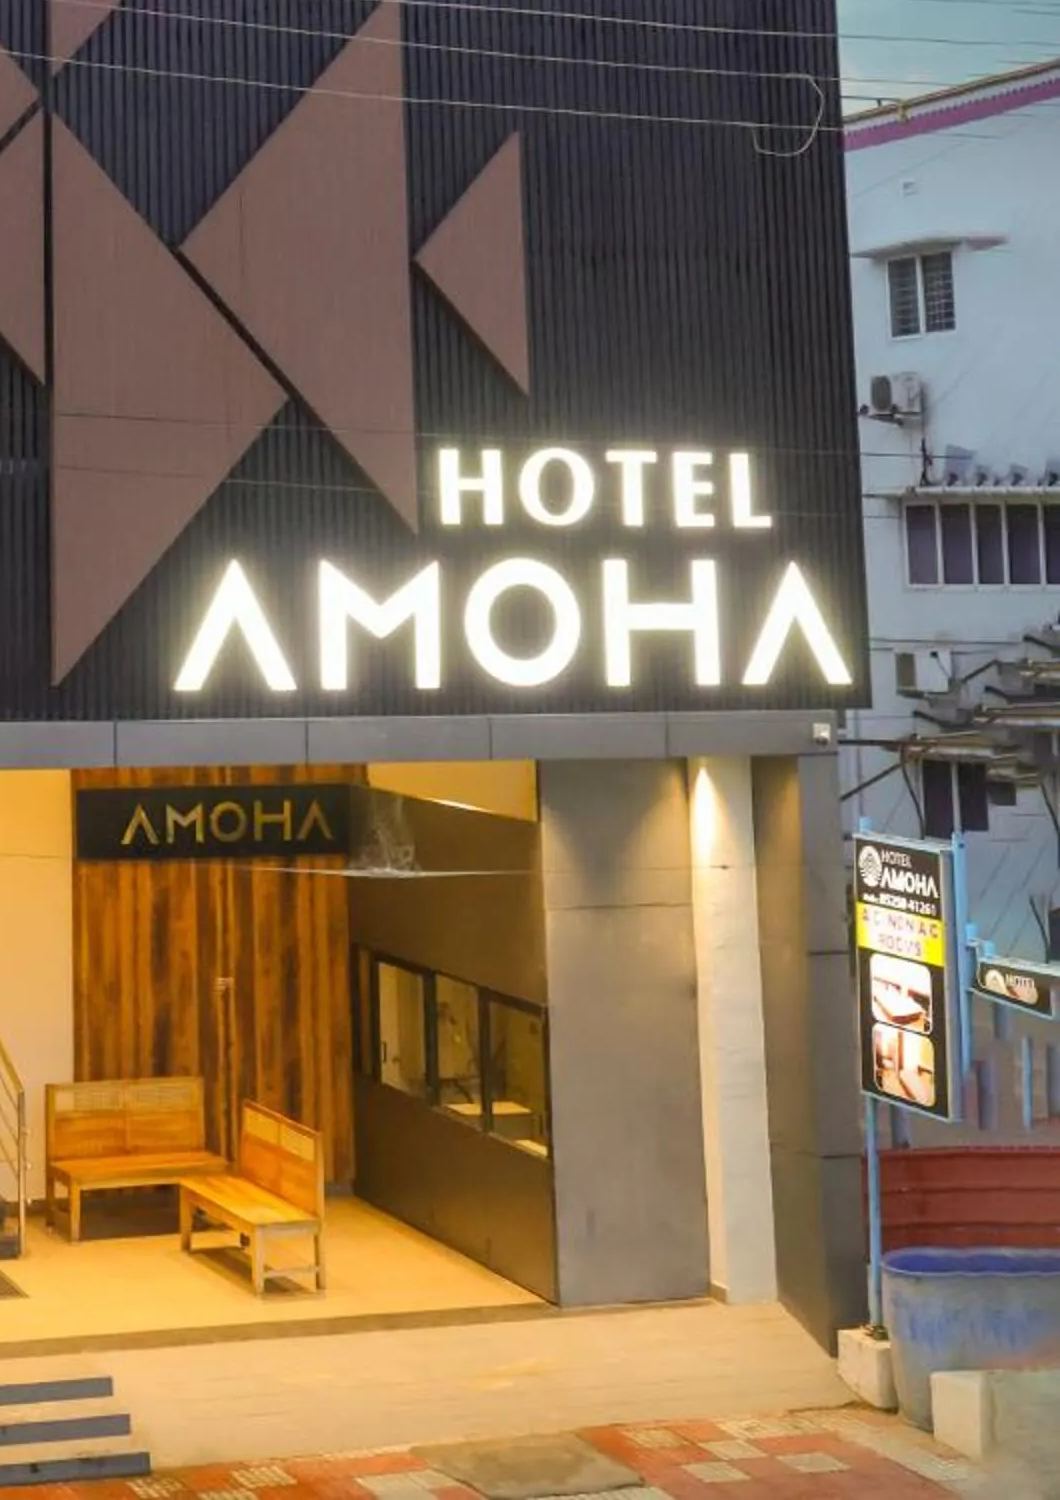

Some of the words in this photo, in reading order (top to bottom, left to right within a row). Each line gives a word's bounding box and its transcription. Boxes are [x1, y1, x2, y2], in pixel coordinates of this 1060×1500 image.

[438, 447, 772, 528] HOTEL
[173, 556, 853, 692] AMOHA
[120, 799, 334, 846] AMOHA
[881, 848, 912, 869] HOTEL
[880, 866, 939, 899] AMOHA
